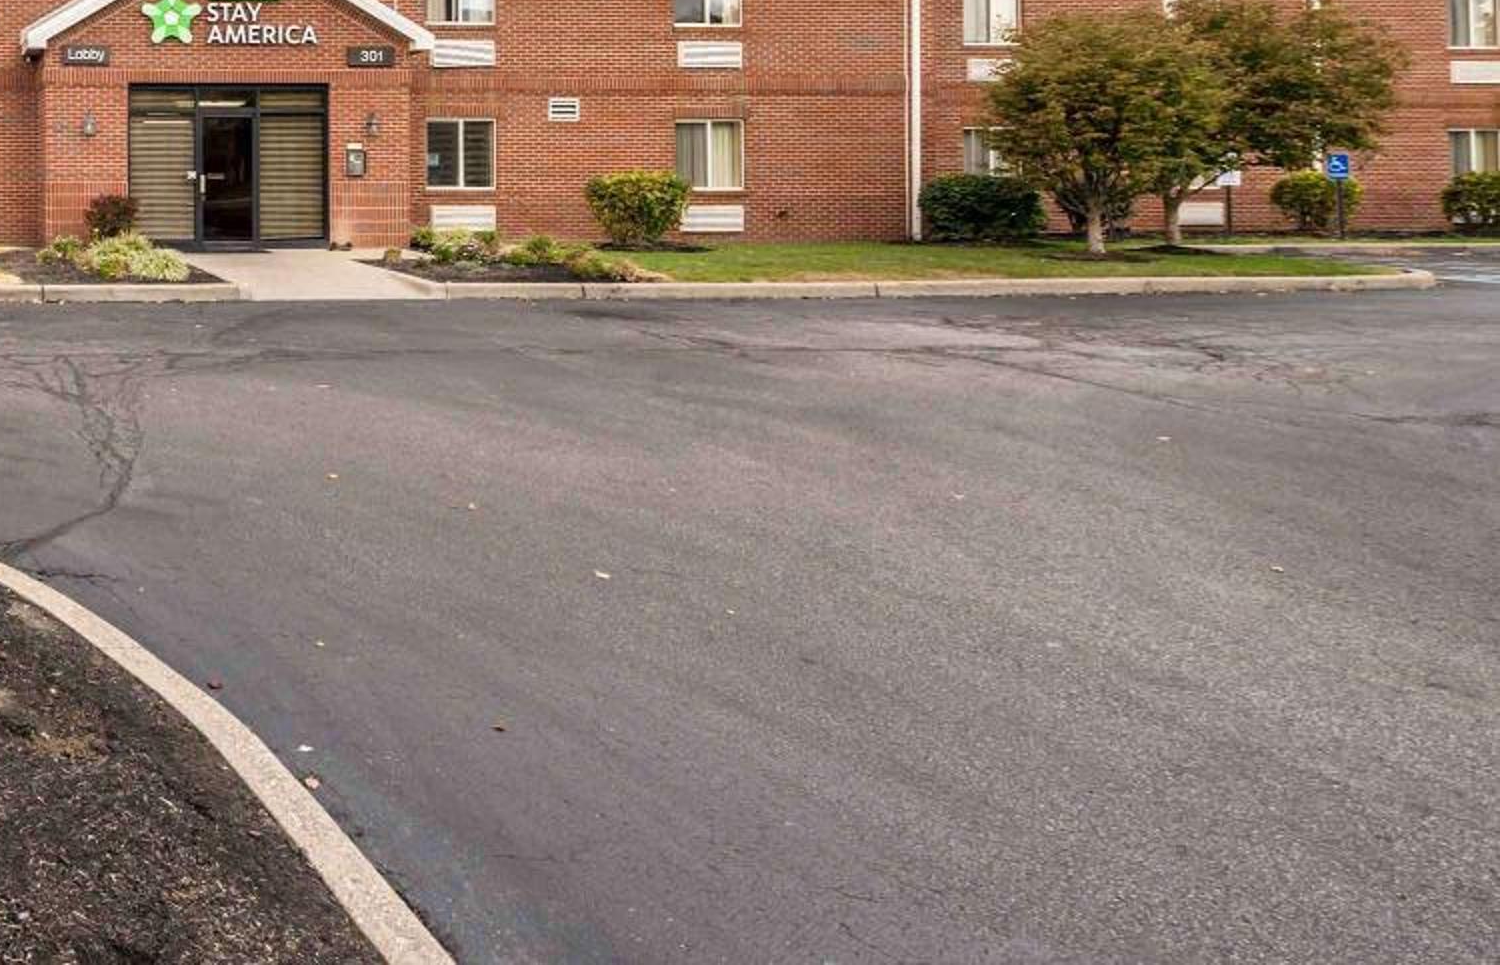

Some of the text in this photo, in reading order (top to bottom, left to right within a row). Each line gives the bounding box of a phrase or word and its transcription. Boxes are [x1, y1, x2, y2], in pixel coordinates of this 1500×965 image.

[207, 2, 263, 22] STAY
[207, 24, 318, 44] AMERICA
[67, 48, 105, 63] Lobby
[360, 50, 384, 62] 301
